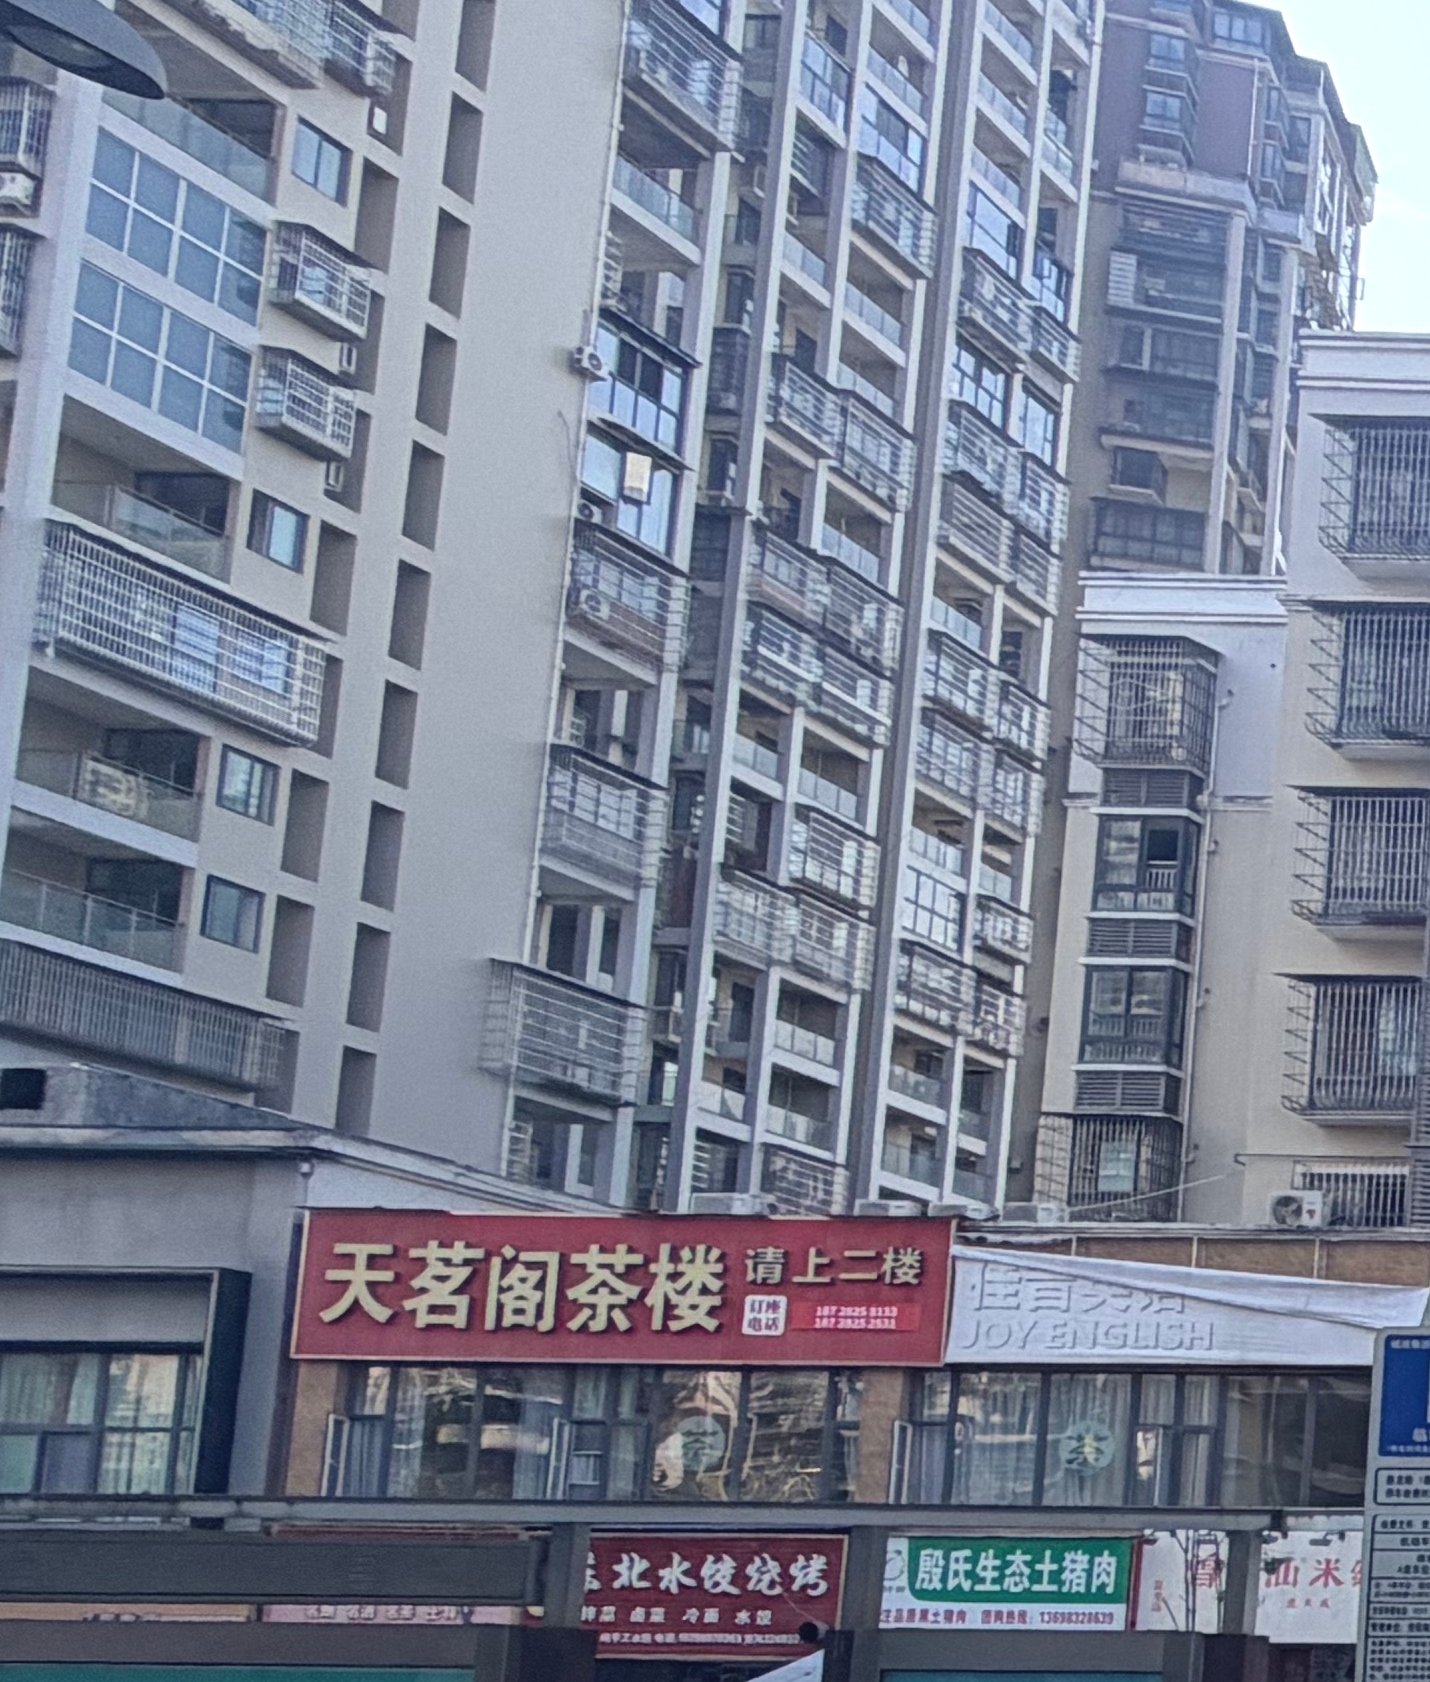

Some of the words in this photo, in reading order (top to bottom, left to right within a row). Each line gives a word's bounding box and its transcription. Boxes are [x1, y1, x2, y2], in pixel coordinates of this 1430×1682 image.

[744, 1246, 922, 1285] 请上二楼
[319, 1241, 724, 1334] 天茗阁茶楼
[747, 1316, 780, 1332] 电话
[963, 1322, 1036, 1349] JOY
[1044, 1322, 1214, 1351] ENGLISH
[914, 1548, 1119, 1595] 殷氏生态土猪肉
